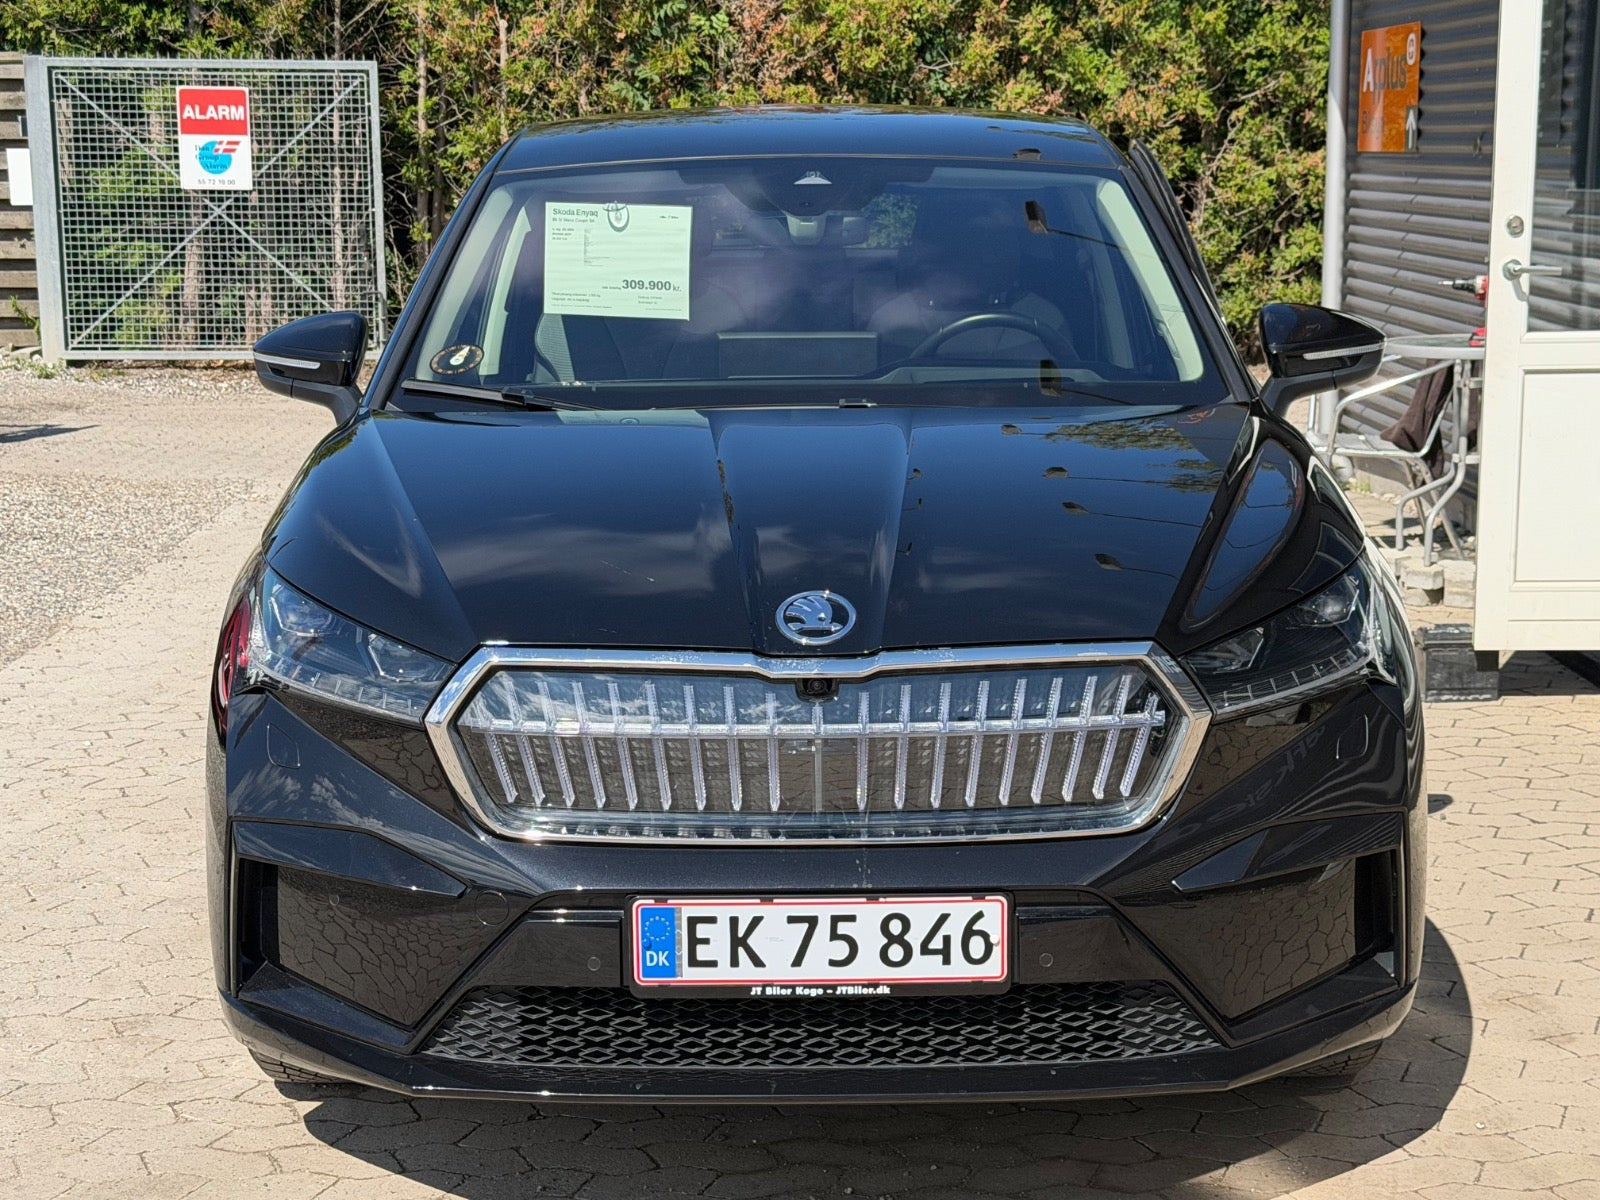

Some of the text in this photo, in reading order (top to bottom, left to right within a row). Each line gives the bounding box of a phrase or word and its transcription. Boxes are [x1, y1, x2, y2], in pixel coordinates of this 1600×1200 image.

[183, 104, 245, 120] ALARM
[552, 208, 599, 218] Skoda Enyaq
[622, 279, 682, 292] 309.900 kr.
[687, 910, 994, 968] EK 75 846
[646, 951, 670, 966] DK
[750, 987, 763, 995] JT
[765, 986, 792, 995] Biler
[835, 985, 891, 995] JTBiler.dk
